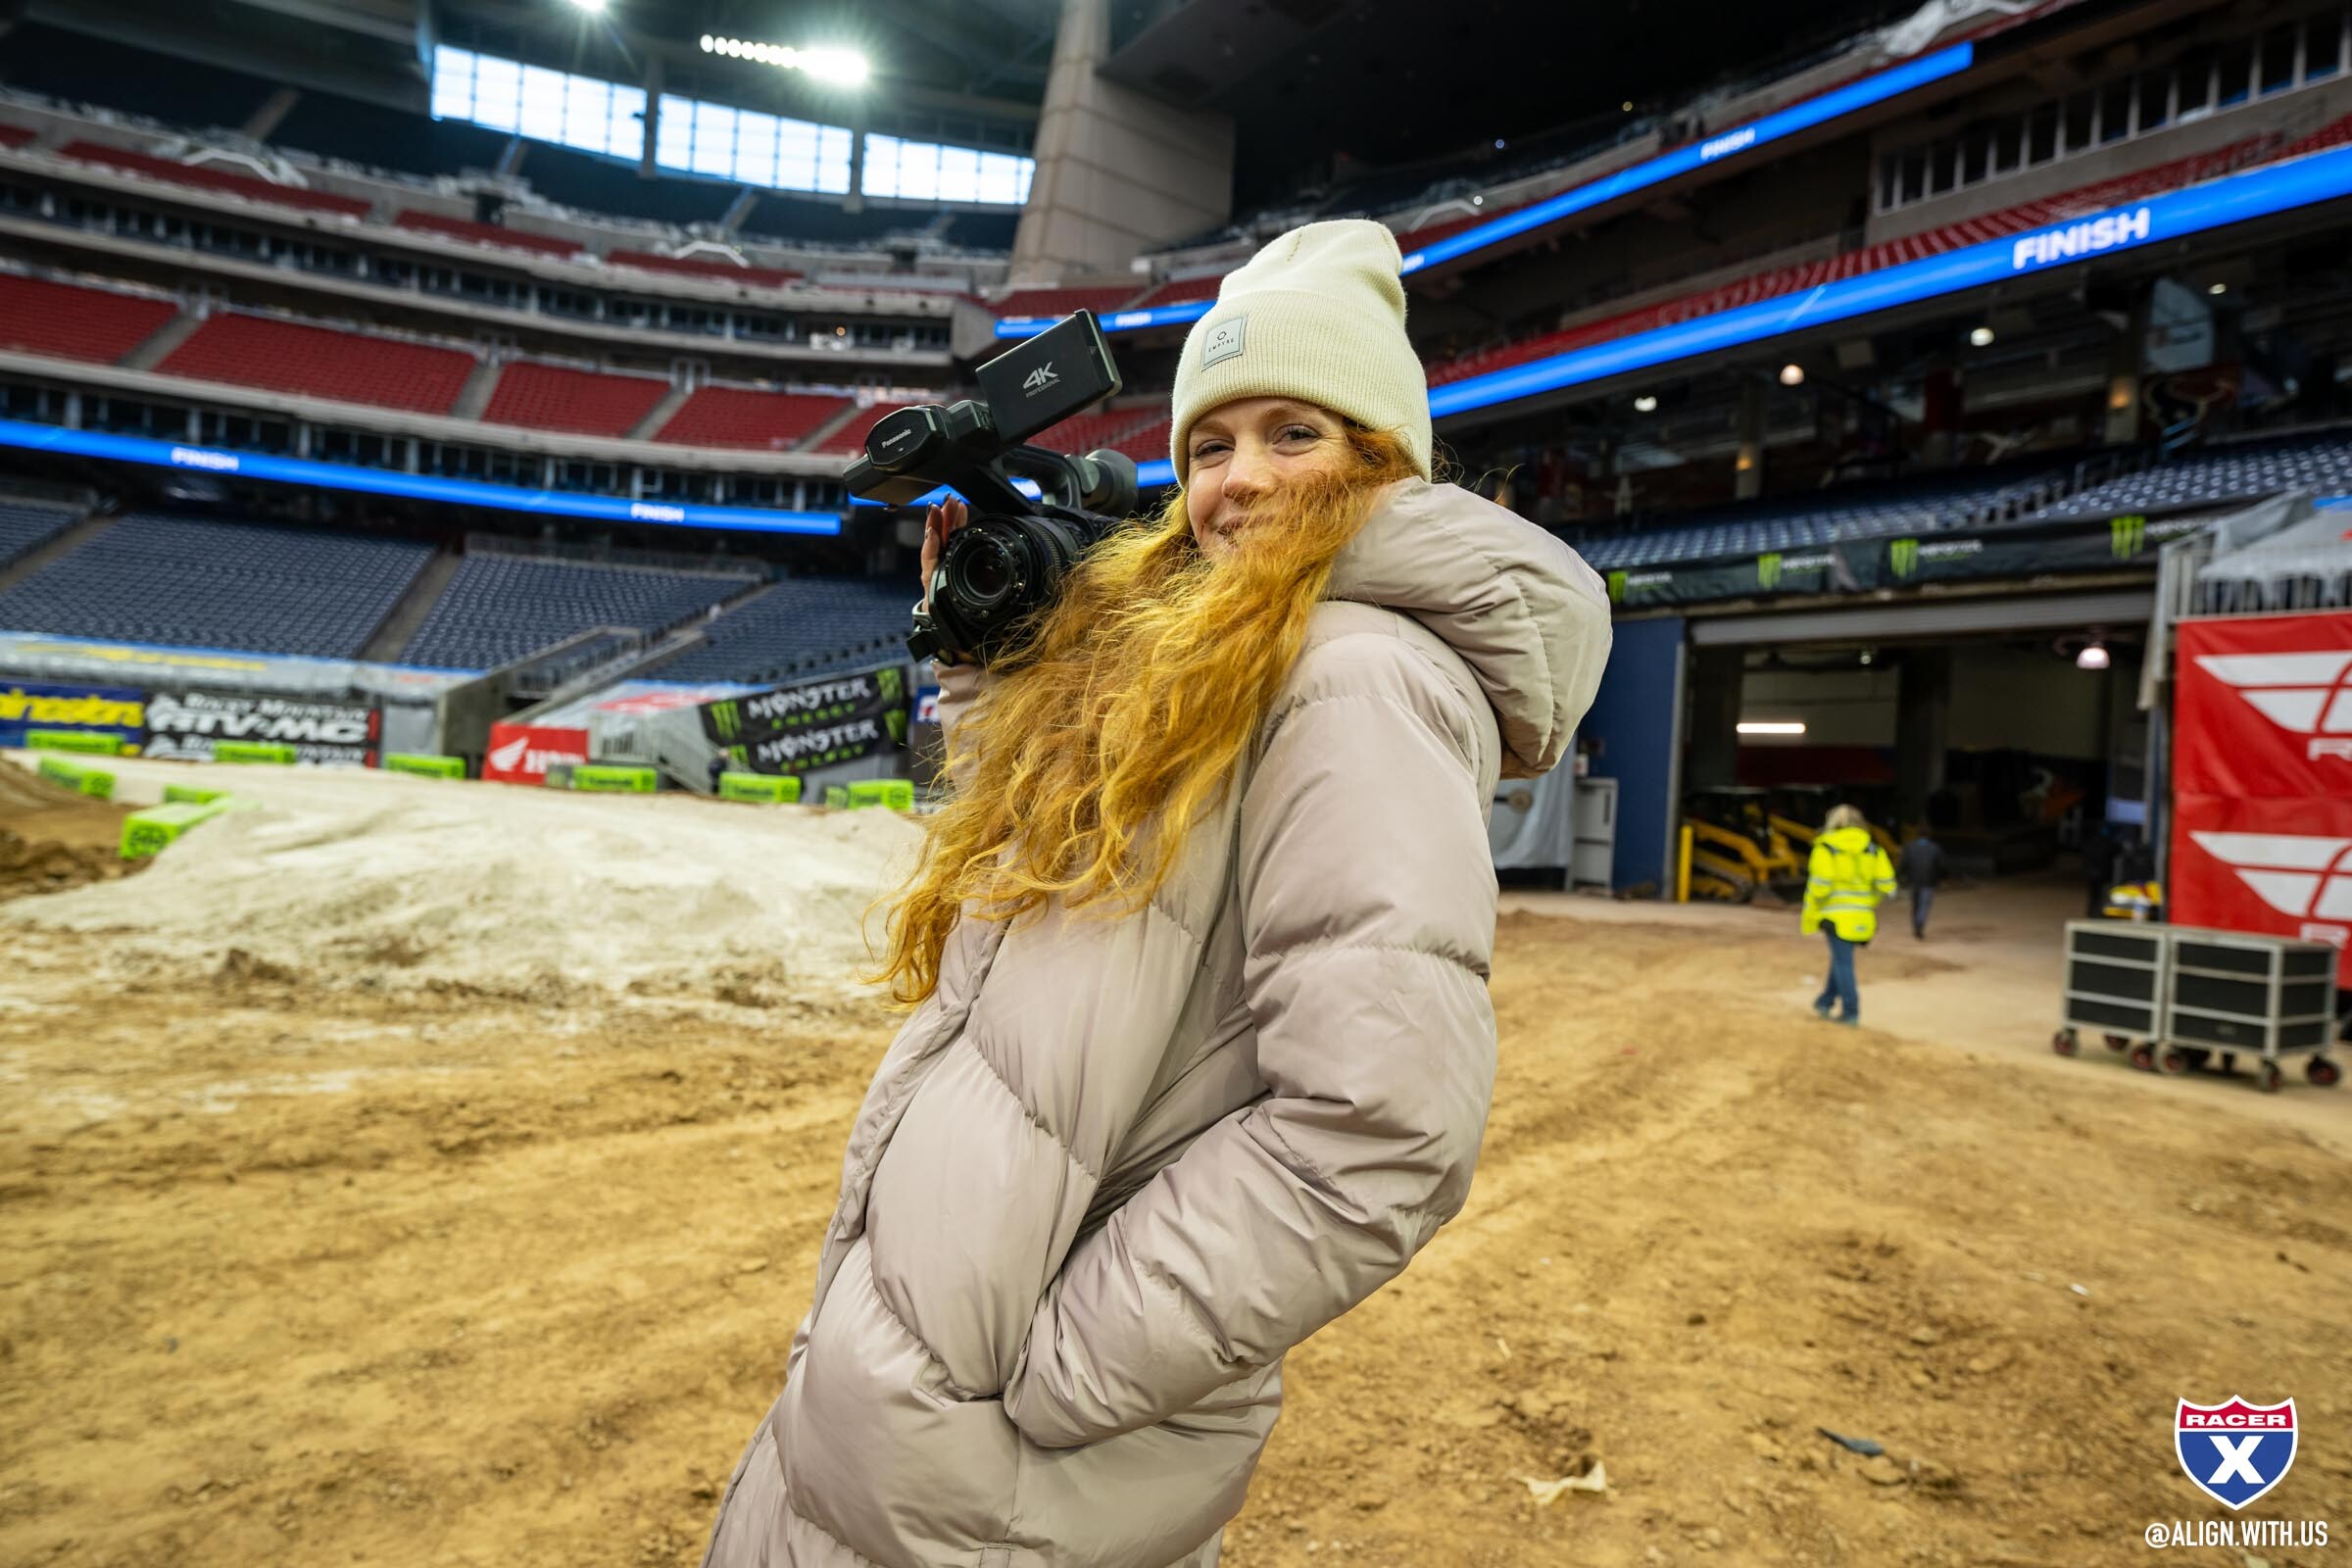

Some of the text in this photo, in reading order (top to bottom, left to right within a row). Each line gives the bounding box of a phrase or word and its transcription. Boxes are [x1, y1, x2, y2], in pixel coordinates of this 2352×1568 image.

[1700, 126, 1756, 161] FINISH
[2012, 207, 2151, 270] FINISH
[1022, 361, 1059, 389] 4K
[1025, 376, 1061, 398] PROFESSIONAL
[881, 428, 911, 449] Panasonic
[171, 446, 239, 471] FINISH
[630, 503, 685, 522] FINISH
[748, 677, 871, 718] MONSTER
[757, 719, 878, 761] MONSTER
